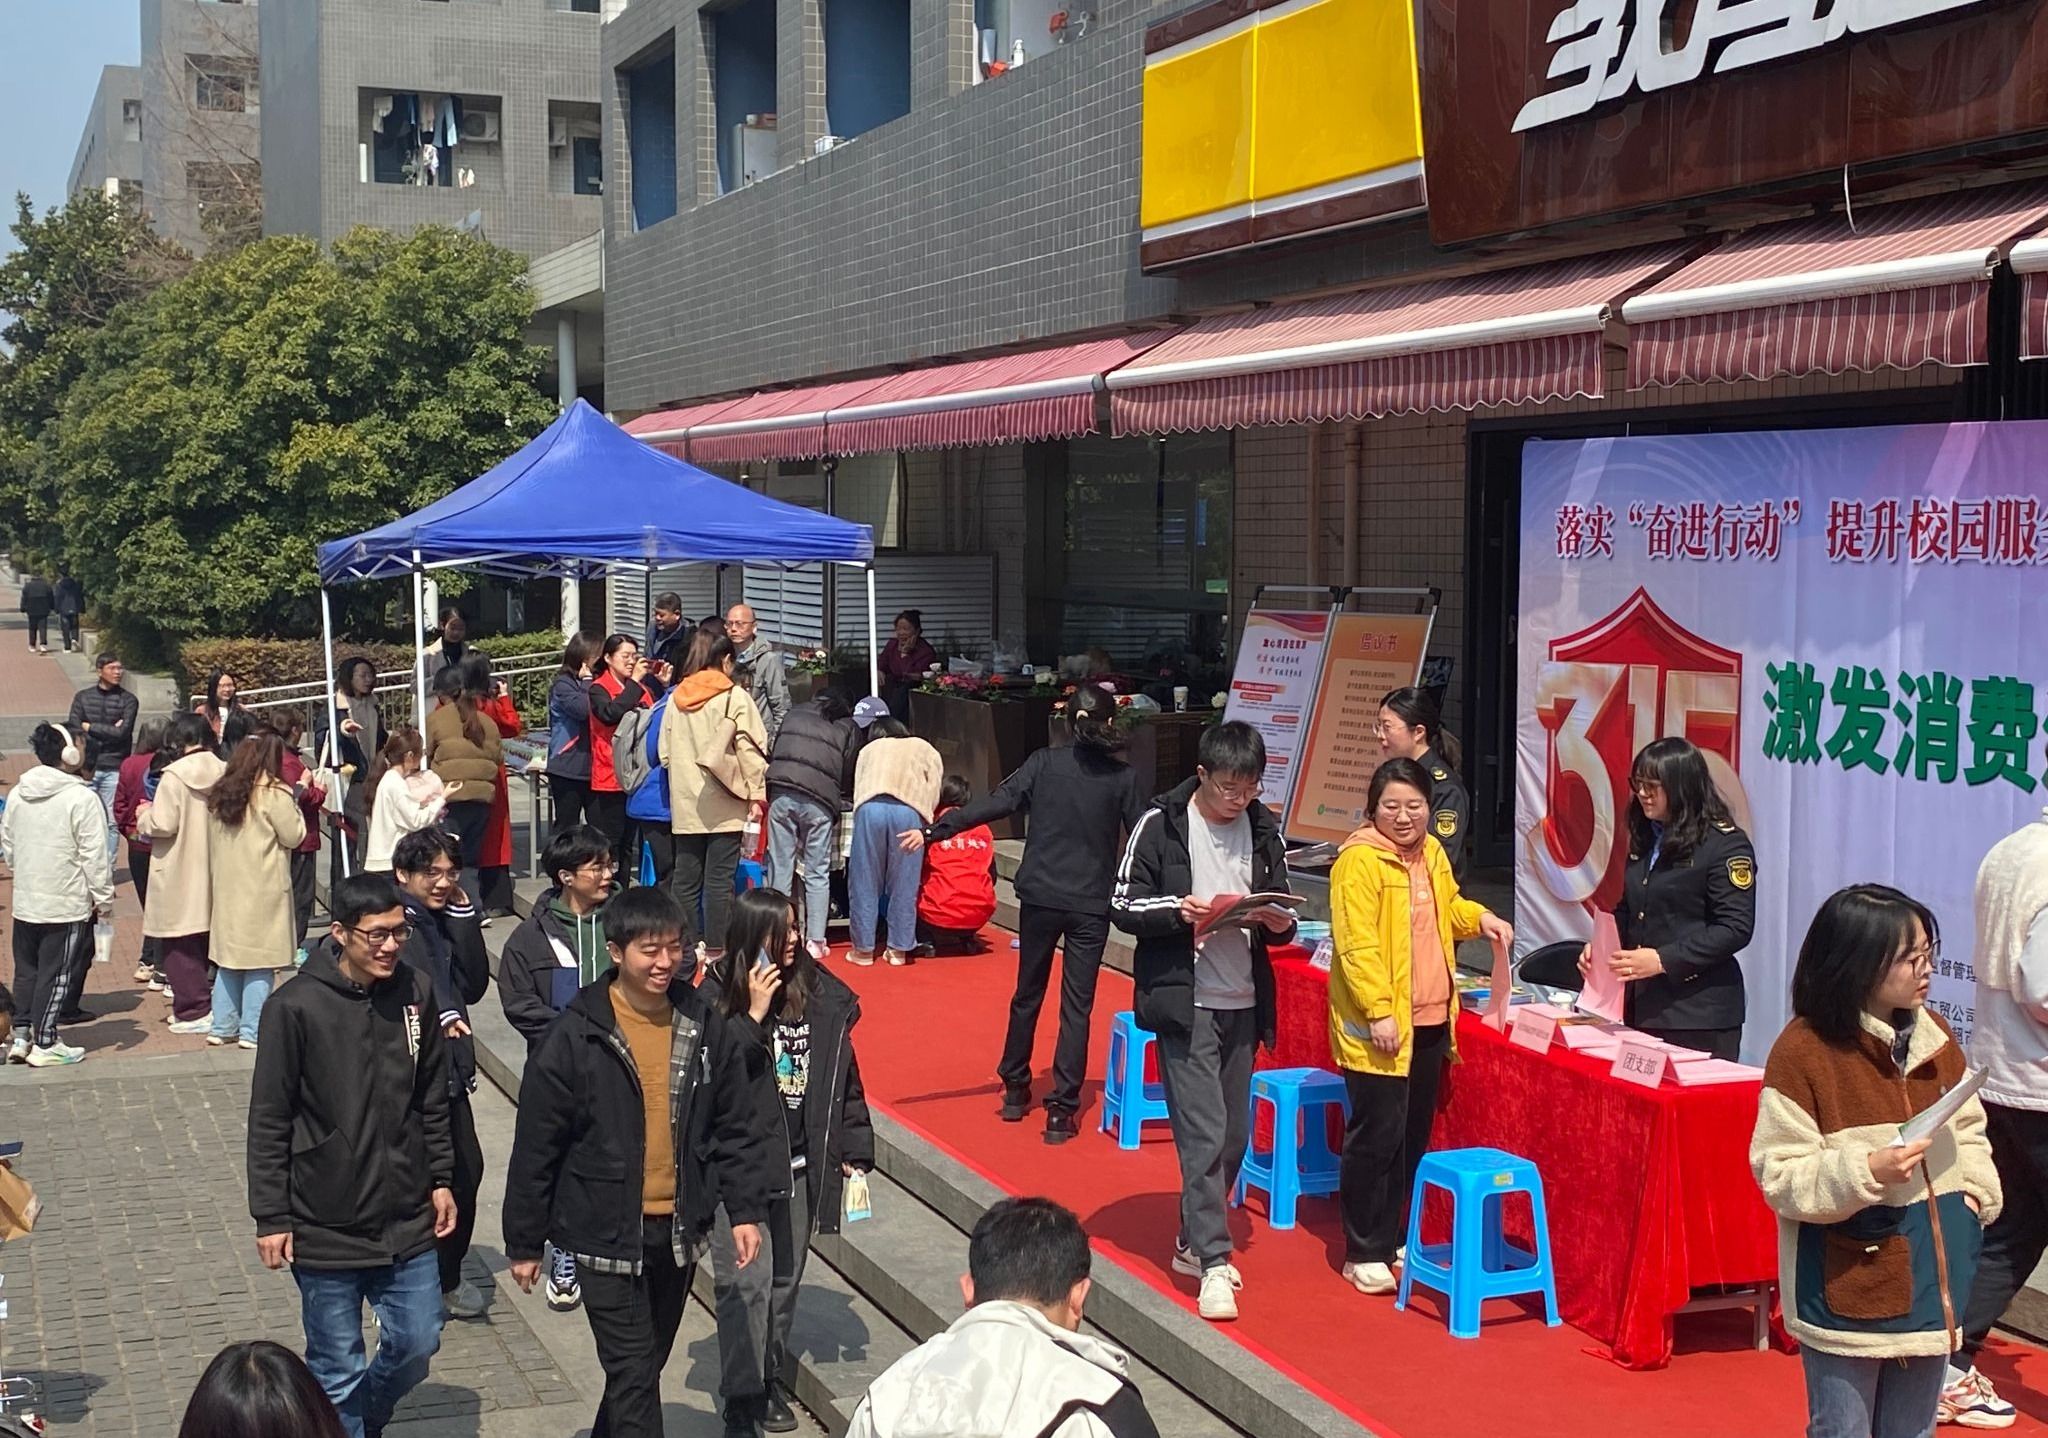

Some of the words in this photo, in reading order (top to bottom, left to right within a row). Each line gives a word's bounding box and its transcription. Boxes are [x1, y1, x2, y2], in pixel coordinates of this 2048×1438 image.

[1826, 497, 2048, 562] 提升校园服
[1762, 661, 2048, 794] 激发消费
[1623, 1052, 1657, 1075] 团支部
